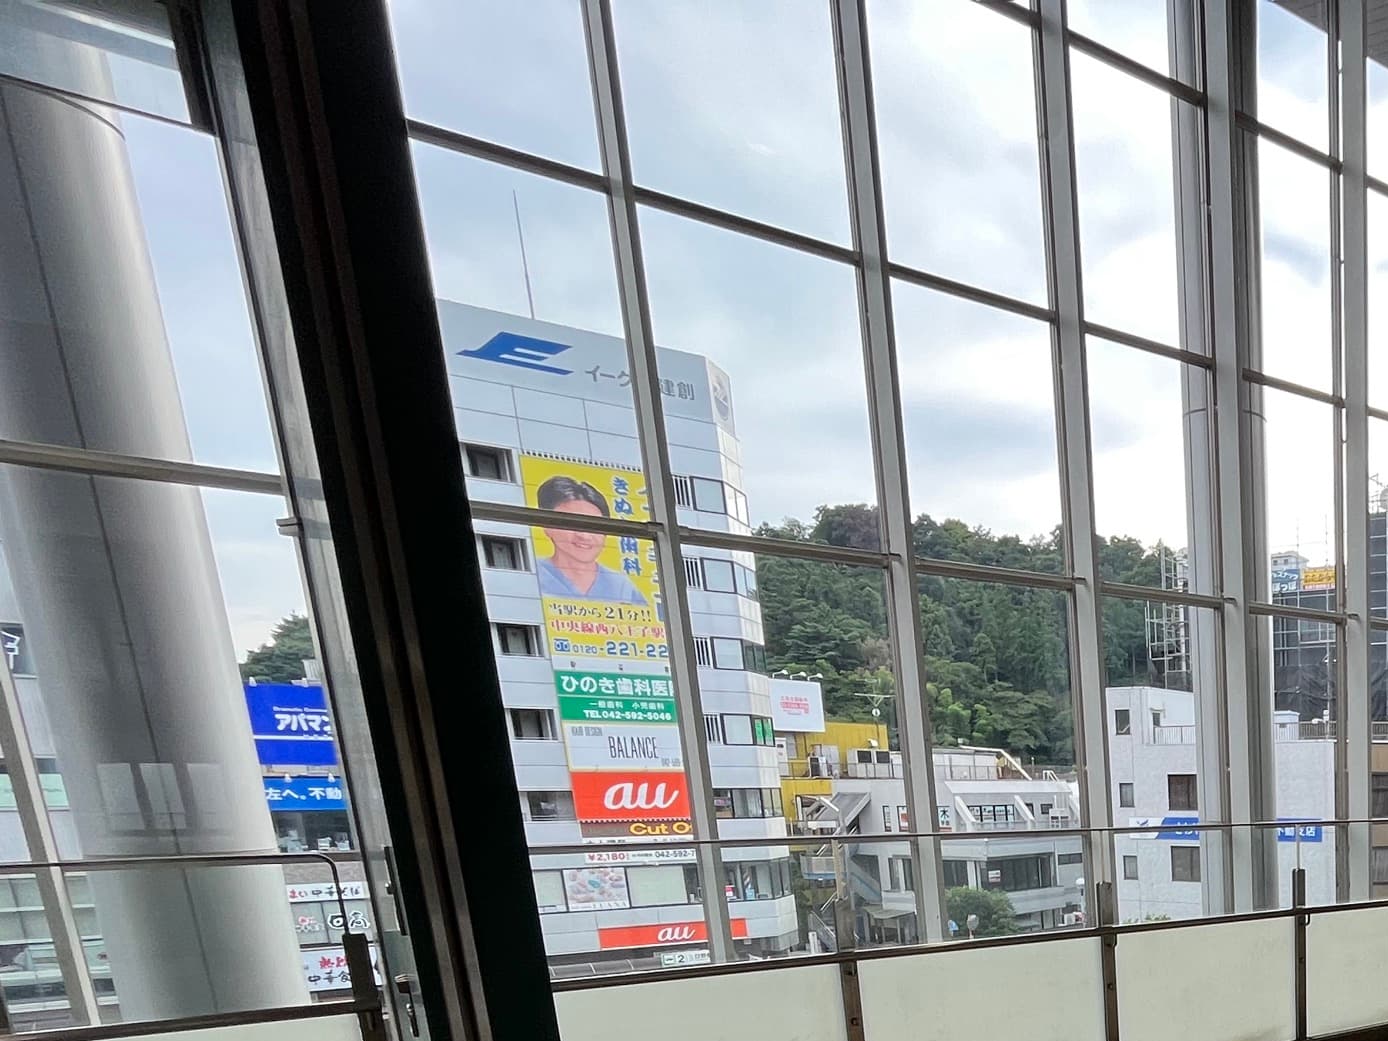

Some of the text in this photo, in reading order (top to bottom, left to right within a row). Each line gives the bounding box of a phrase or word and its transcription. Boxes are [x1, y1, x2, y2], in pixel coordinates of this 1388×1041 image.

[560, 674, 675, 697] ひのき歯科医
[608, 735, 659, 759] BALANCE
[604, 782, 679, 810] au
[629, 821, 693, 836] Cut O
[657, 924, 695, 942] au
